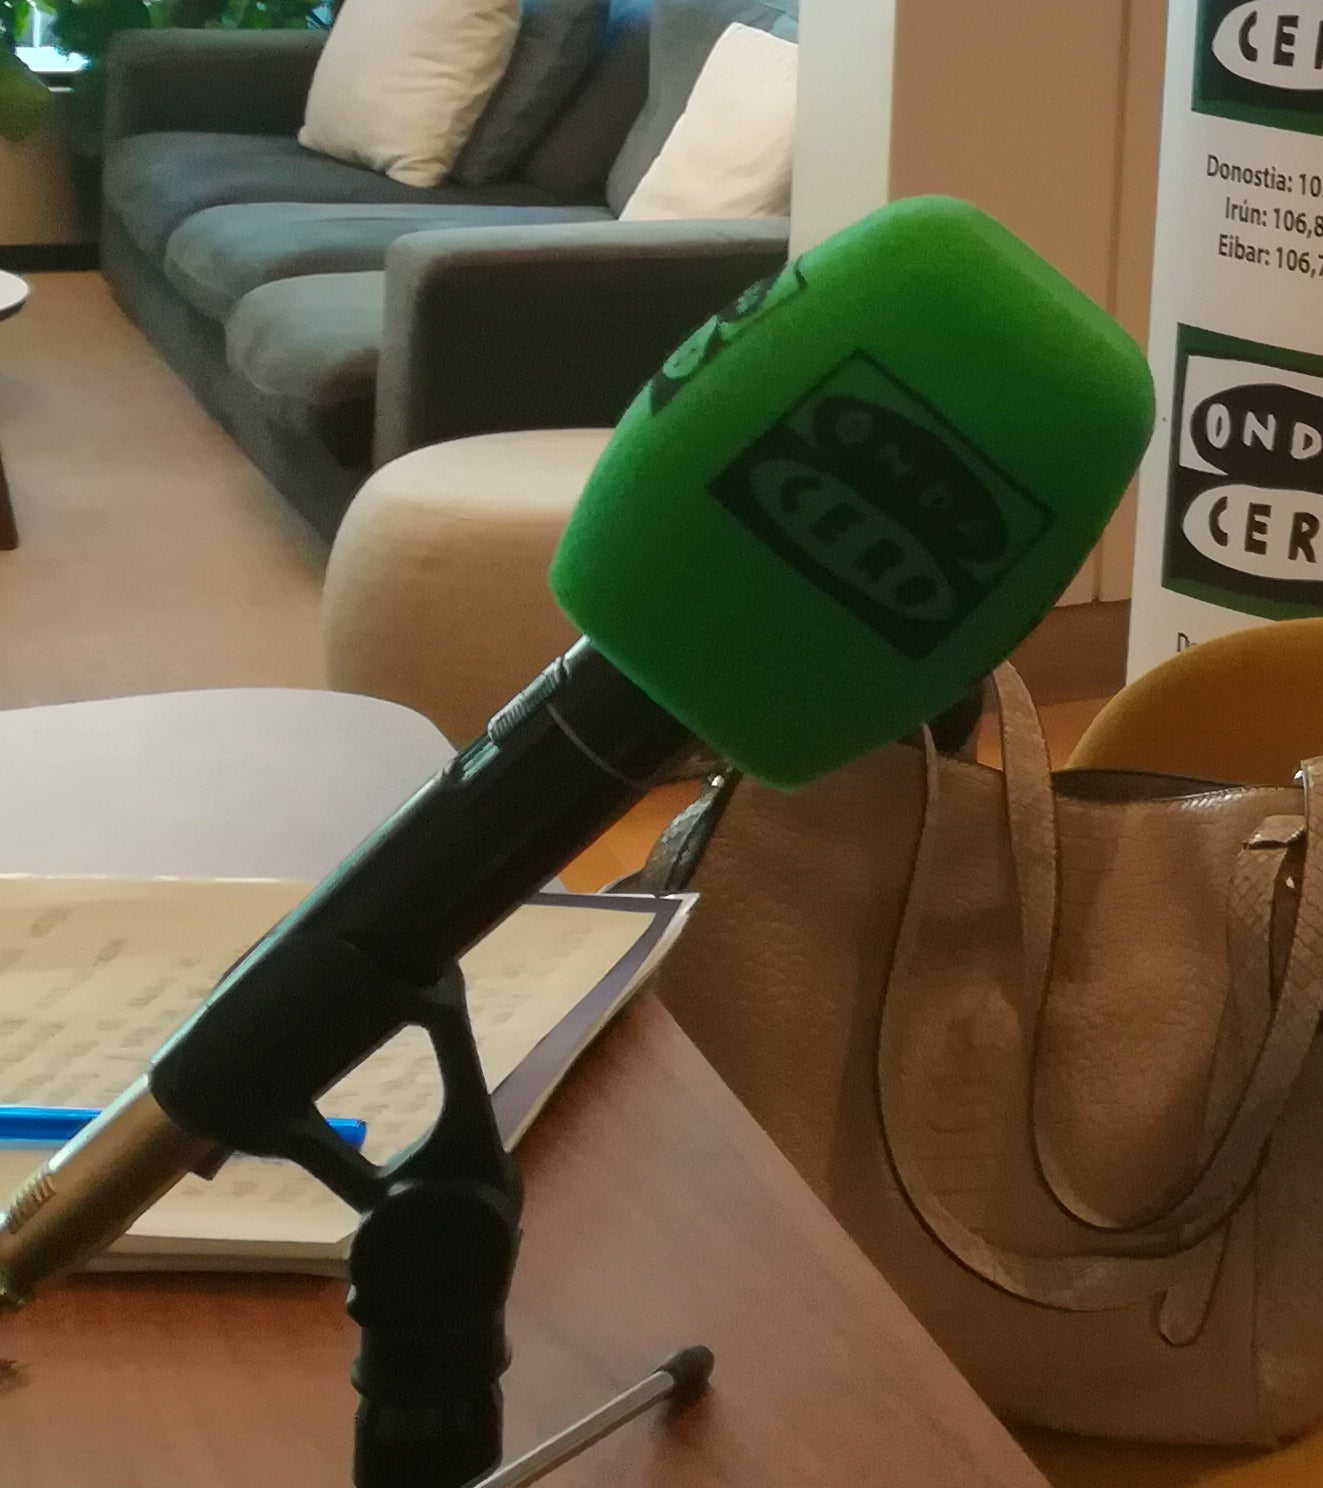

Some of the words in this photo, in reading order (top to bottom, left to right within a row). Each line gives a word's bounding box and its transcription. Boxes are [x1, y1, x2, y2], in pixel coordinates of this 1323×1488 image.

[1206, 153, 1293, 193] Donostia:
[1225, 196, 1268, 227] Irún:
[1218, 233, 1271, 266] Eibar:
[778, 475, 939, 608] CERO
